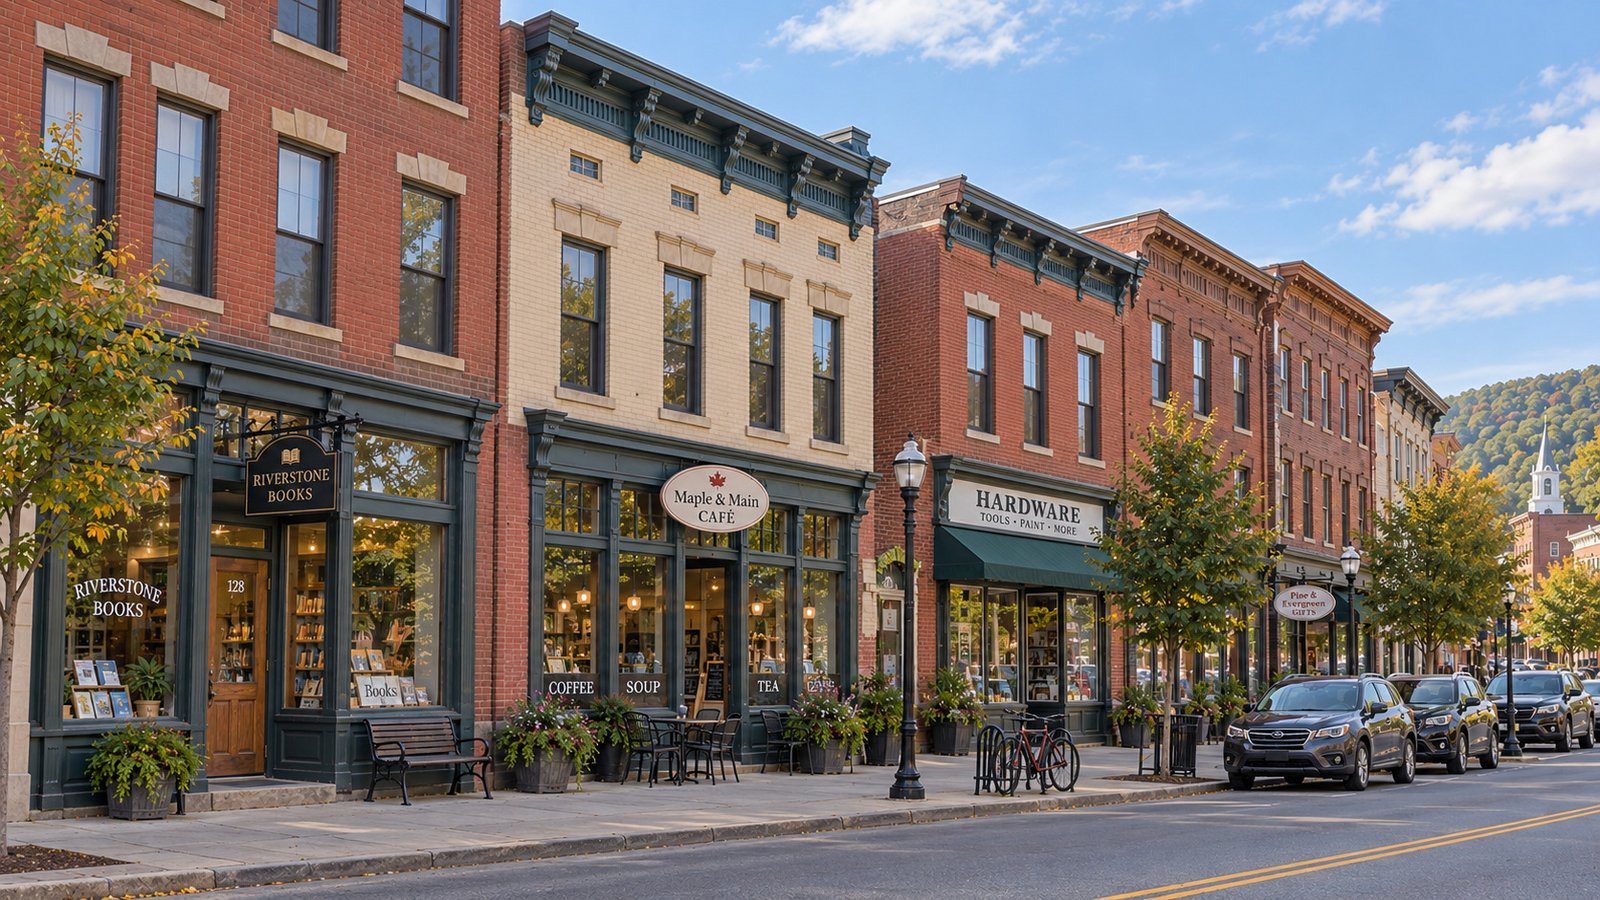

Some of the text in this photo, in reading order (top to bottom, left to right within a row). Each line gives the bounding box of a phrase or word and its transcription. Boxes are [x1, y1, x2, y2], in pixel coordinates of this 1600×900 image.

[253, 468, 330, 487] RIVERSTONE
[268, 487, 313, 503] BOOKS
[674, 489, 759, 508] Maple & Main
[976, 489, 1081, 524] HARDWARE
[980, 512, 1077, 536] TOOLS PAINT MORE
[73, 577, 162, 605] RIVERSTONE
[227, 579, 245, 593] 128
[1310, 591, 1317, 599] &
[92, 600, 144, 618] BOOKS
[365, 684, 398, 698] Books
[548, 681, 595, 695] COFFEE
[626, 680, 661, 694] SOUP
[757, 680, 779, 692] TEA
